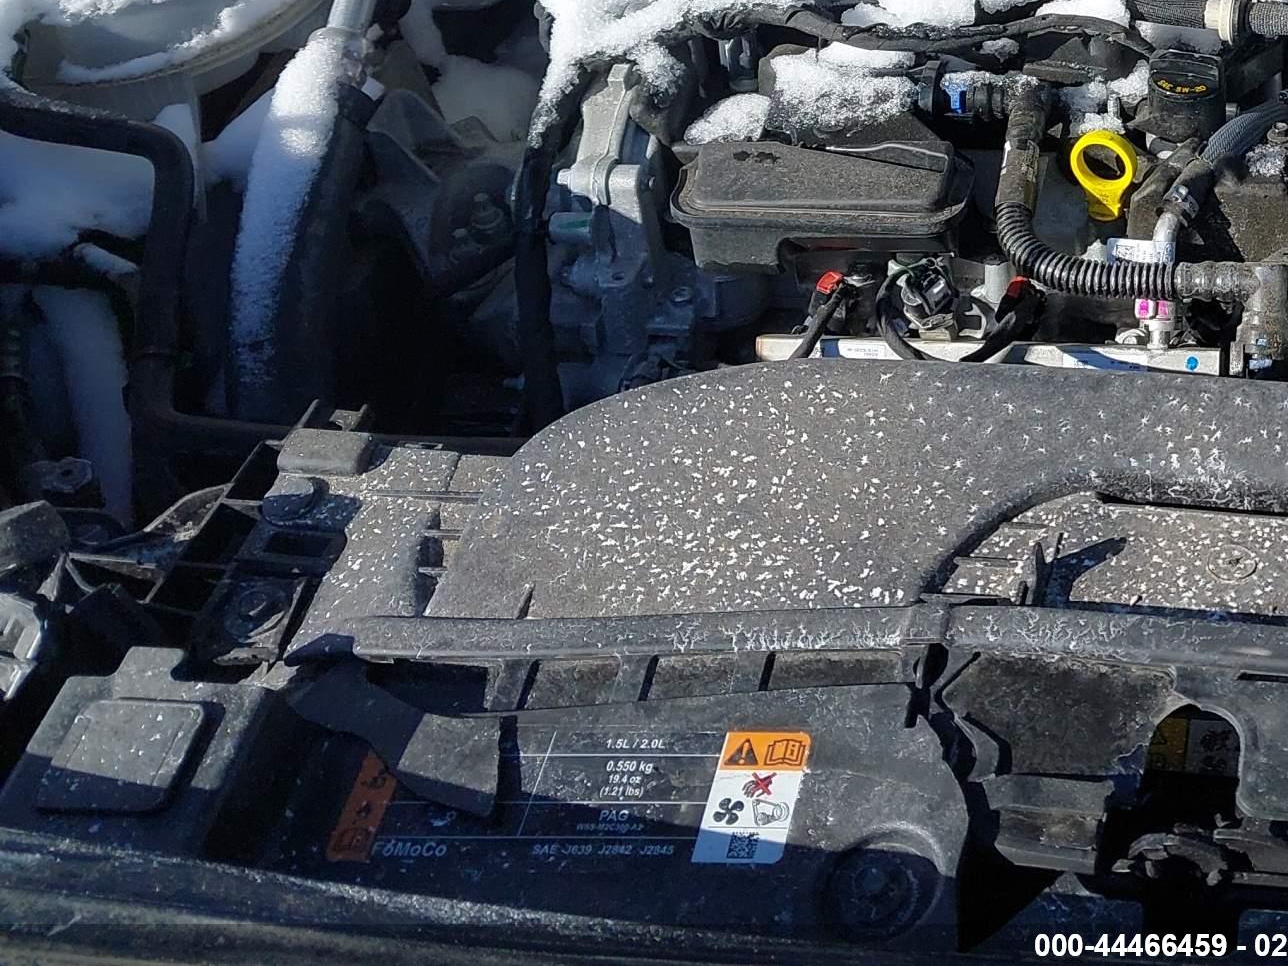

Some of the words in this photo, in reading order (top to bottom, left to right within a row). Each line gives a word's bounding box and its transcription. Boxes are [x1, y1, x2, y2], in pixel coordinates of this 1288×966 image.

[606, 738, 630, 749] 1.5L
[632, 738, 639, 749] /
[640, 738, 666, 749] 2.0L
[606, 760, 637, 772] 0.550
[638, 760, 654, 775] kg
[608, 773, 628, 784] 19.4
[629, 775, 642, 784] oz
[599, 786, 624, 798] (1.21
[624, 786, 644, 798] lbs)
[599, 809, 630, 822] PAG
[533, 844, 560, 856] SAE
[562, 844, 593, 856] J639
[639, 844, 675, 857] J2845
